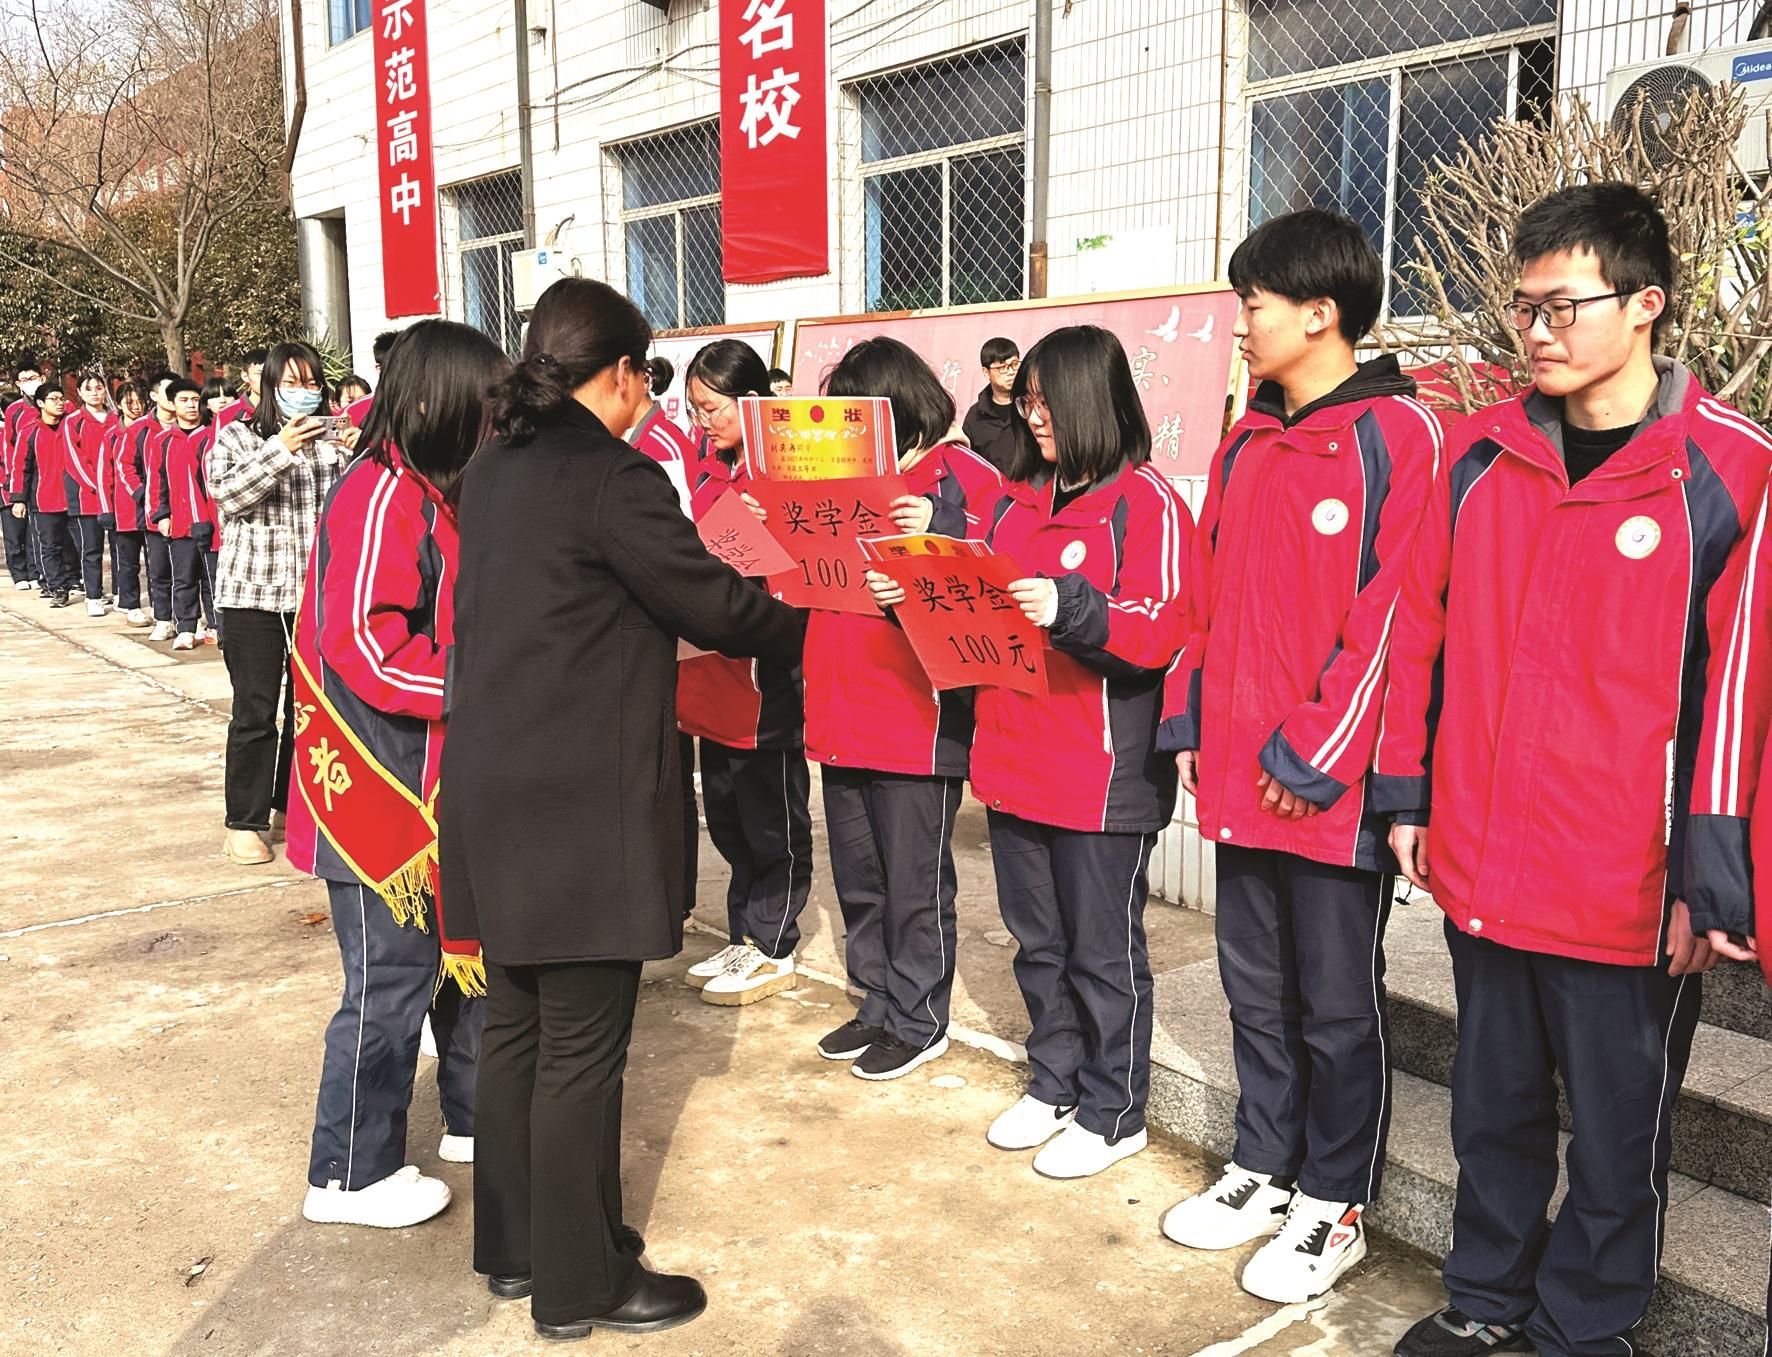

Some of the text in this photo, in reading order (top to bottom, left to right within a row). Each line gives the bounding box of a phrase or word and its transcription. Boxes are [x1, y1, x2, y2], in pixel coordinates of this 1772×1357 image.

[738, 0, 801, 150] 名校
[1735, 61, 1772, 77] Midea
[382, 0, 421, 225] 示范高中
[781, 499, 882, 537] 奖学金
[912, 574, 1014, 614] 奖学金
